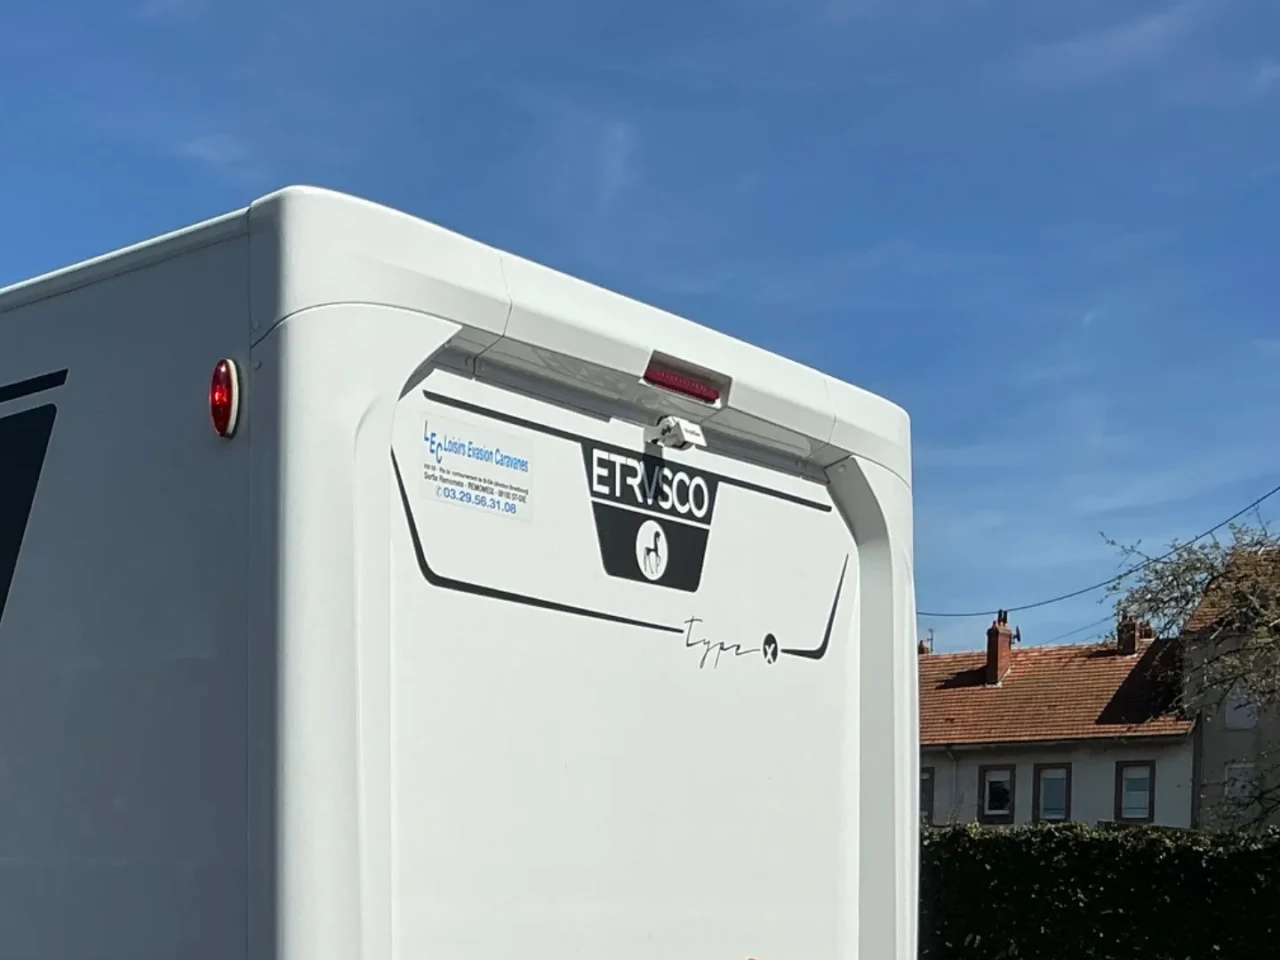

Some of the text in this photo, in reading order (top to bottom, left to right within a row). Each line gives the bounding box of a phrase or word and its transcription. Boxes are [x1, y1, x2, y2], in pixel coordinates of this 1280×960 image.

[444, 434, 466, 456] Loisirs
[467, 441, 493, 463] Evasion
[495, 448, 529, 473] Caravanes
[443, 487, 517, 514] 03.29.56.31.08
